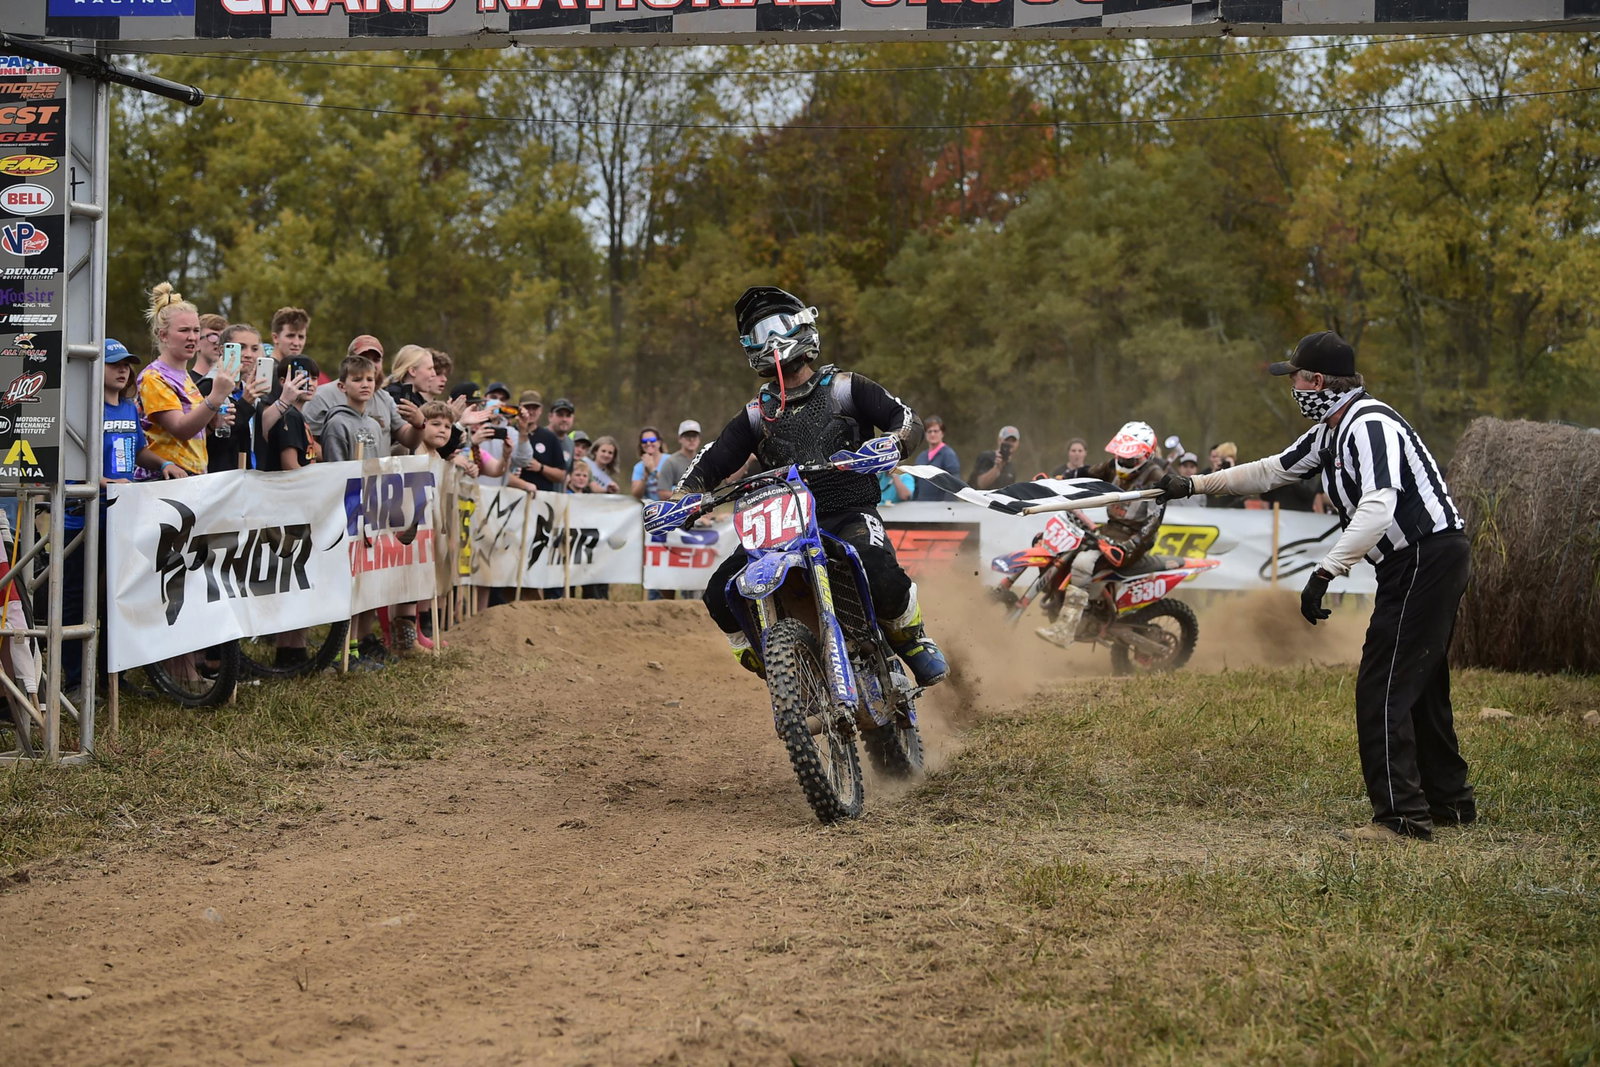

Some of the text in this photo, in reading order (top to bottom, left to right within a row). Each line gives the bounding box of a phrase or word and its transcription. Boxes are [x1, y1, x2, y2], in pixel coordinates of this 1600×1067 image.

[0, 56, 49, 67] PAR
[0, 106, 60, 125] CST
[0, 132, 57, 142] GBC
[0, 158, 57, 170] FMF
[7, 193, 45, 205] BELL
[2, 222, 35, 255] VP
[9, 314, 58, 323] WISECO
[103, 420, 137, 430] BABS
[746, 485, 802, 505] GNCCRACING.OM
[742, 492, 810, 550] 514
[196, 523, 312, 603] THOR
